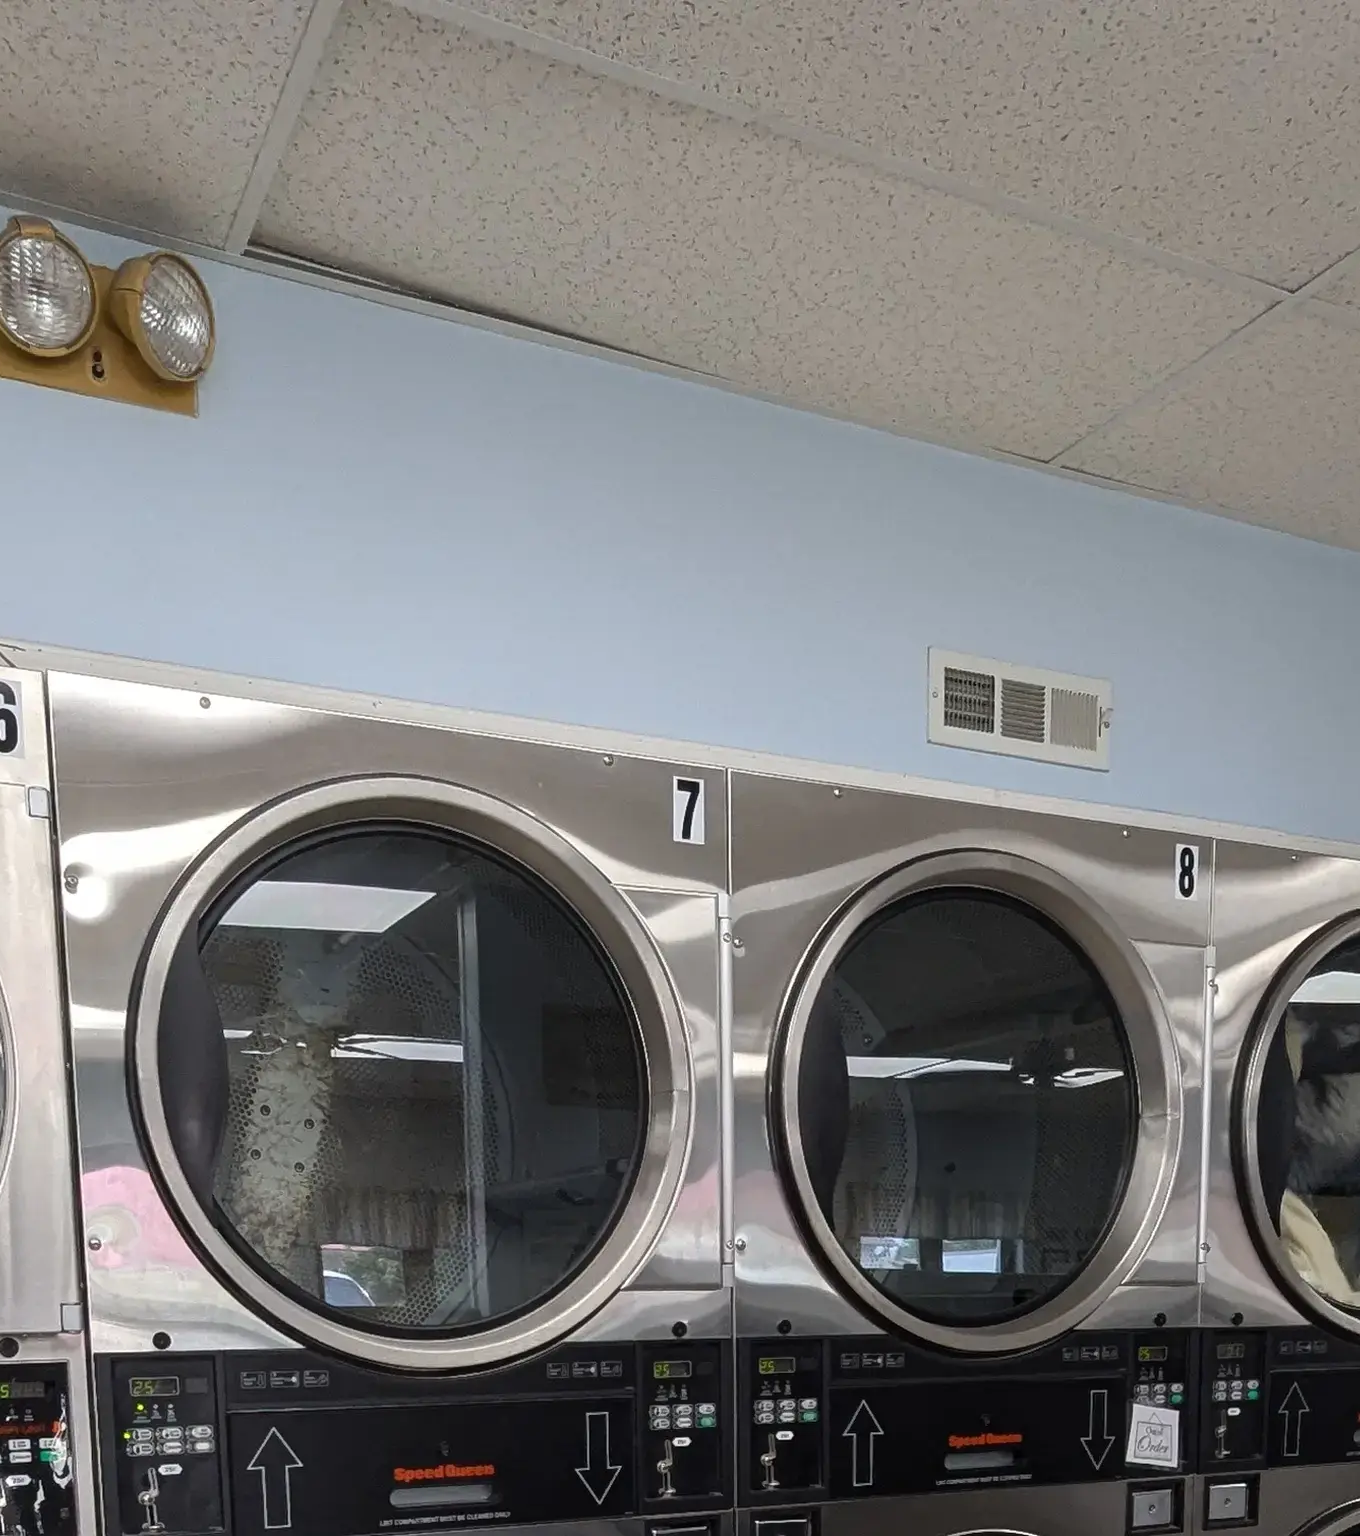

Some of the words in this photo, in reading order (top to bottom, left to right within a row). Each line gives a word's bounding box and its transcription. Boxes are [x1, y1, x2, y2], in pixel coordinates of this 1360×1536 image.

[677, 779, 700, 840] 7
[1179, 847, 1194, 898] 8
[394, 1465, 444, 1482] Speed
[445, 1464, 495, 1478] Queen
